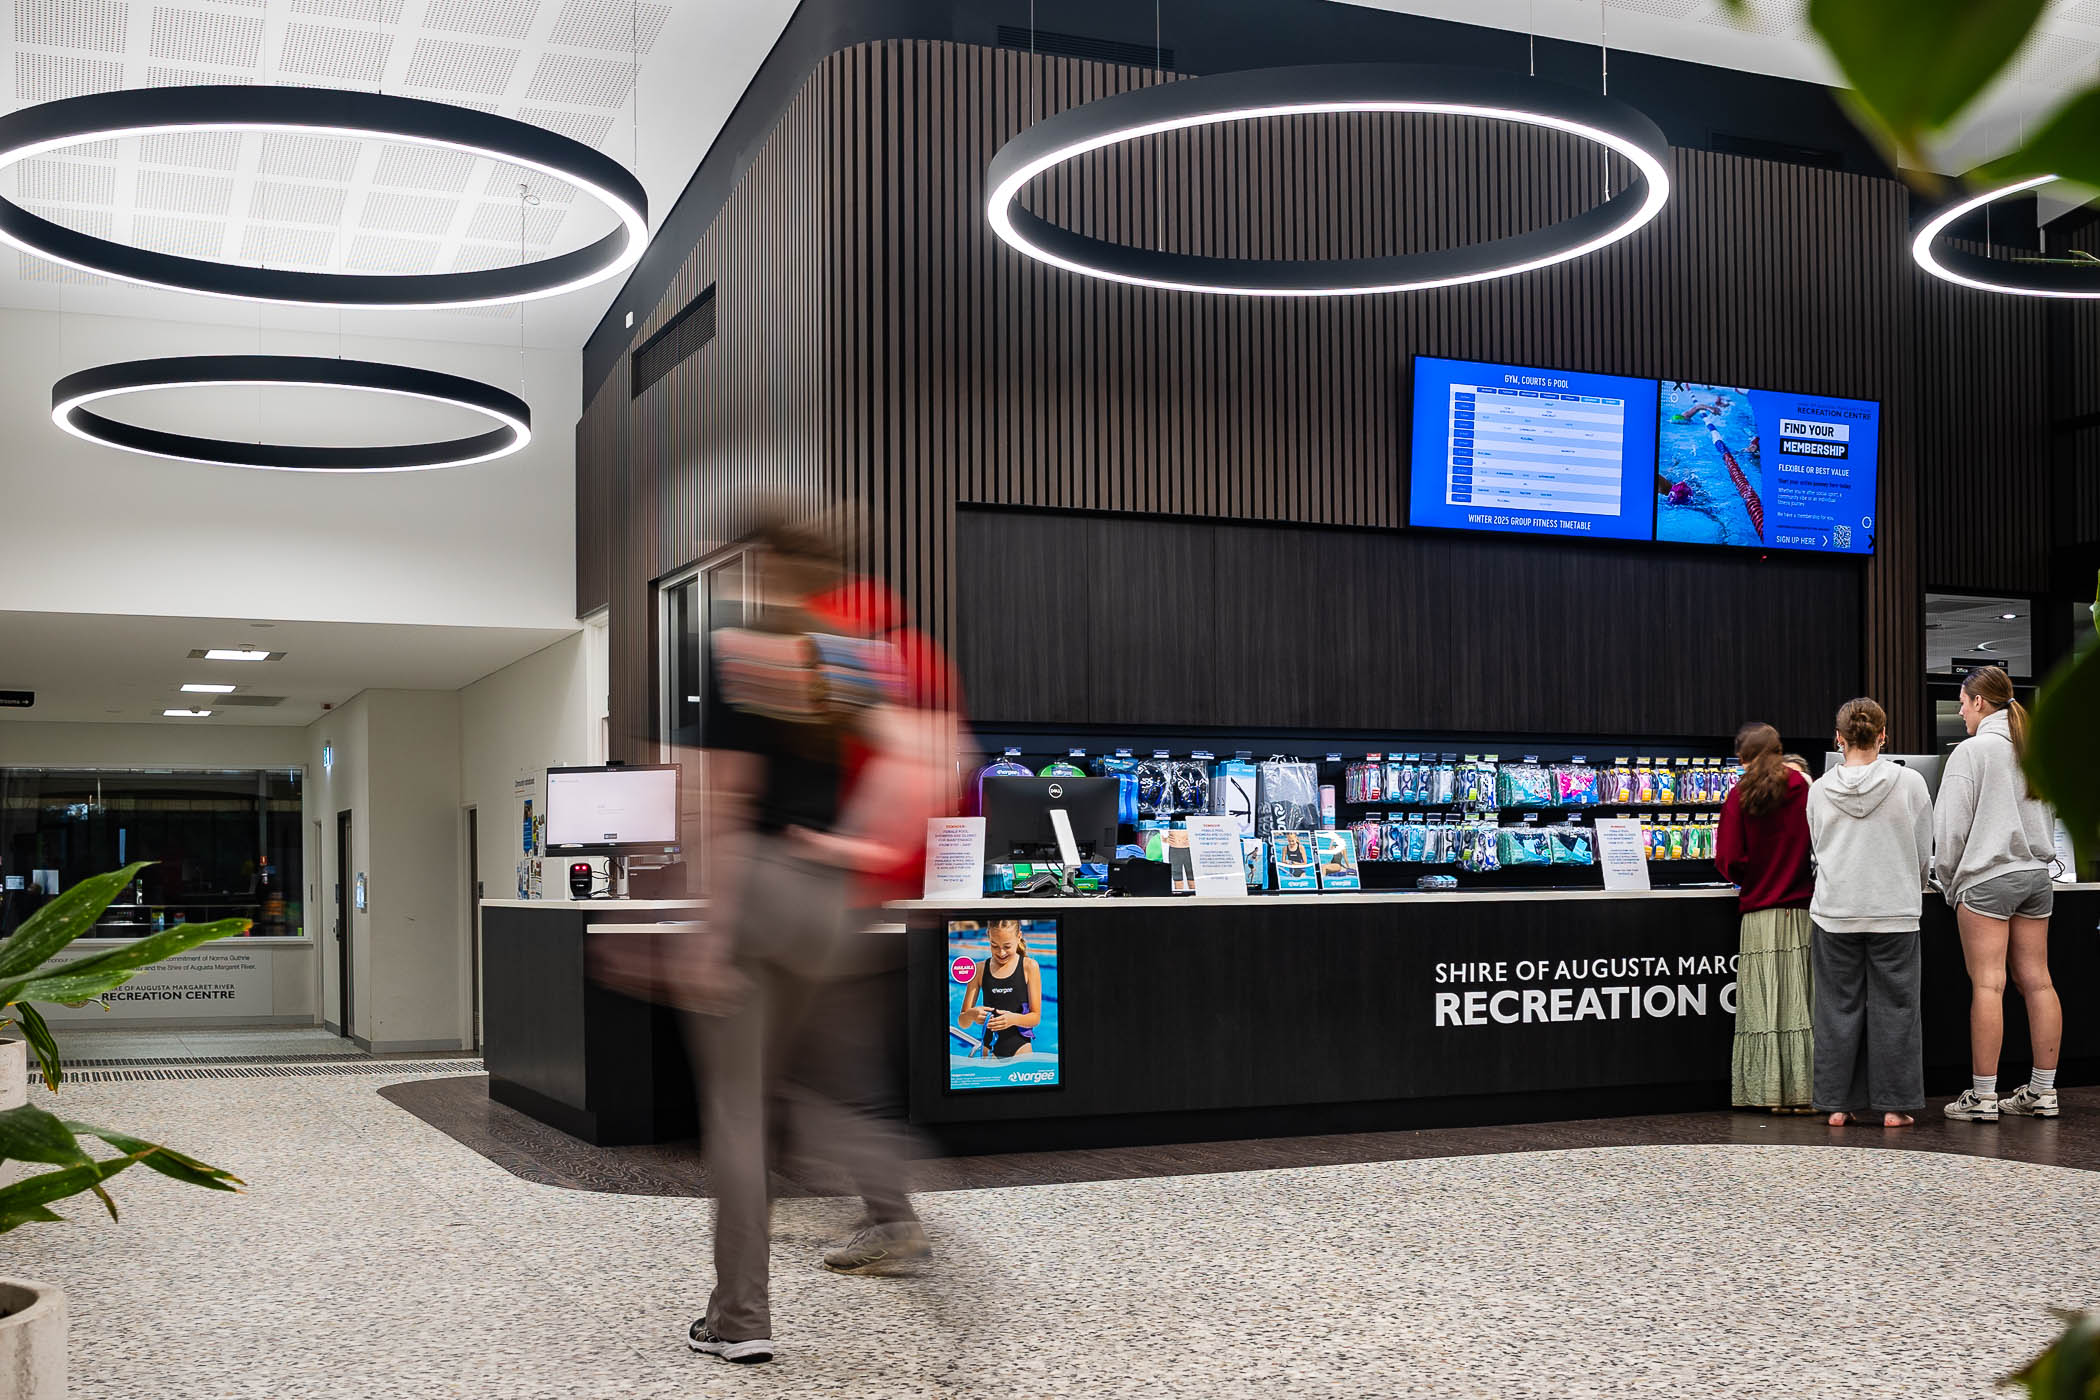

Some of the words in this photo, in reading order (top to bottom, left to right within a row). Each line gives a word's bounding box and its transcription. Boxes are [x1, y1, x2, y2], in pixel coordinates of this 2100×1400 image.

[1505, 375, 1520, 384] GYM,
[1522, 376, 1546, 387] COURTS
[1548, 379, 1552, 387] &
[1554, 379, 1568, 388] POOL
[1798, 408, 1841, 417] RECREATION
[1843, 411, 1871, 420] CENTRE
[1784, 423, 1806, 434] FIND
[1809, 425, 1834, 437] YOUR
[1783, 441, 1845, 456] MEMBERSHIP
[1779, 464, 1804, 473] FLEXIBLE
[1831, 468, 1850, 476] VALUE
[1468, 514, 1492, 524] WINTER
[1494, 516, 1509, 525] 2025
[1510, 517, 1531, 526] GROUP
[1533, 518, 1557, 528] FITNESS
[1560, 520, 1591, 530] TIMETABLE
[1792, 536, 1800, 544] UP
[190, 964, 214, 972] Augusta
[214, 964, 240, 972] Margaret
[1435, 962, 1507, 984] SHIRE
[1516, 960, 1550, 981] OF
[1554, 957, 1671, 980] AUGUSTA
[102, 992, 182, 1001] RECREATION
[186, 991, 235, 1000] CENTRE
[1435, 983, 1707, 1027] RECREATION
